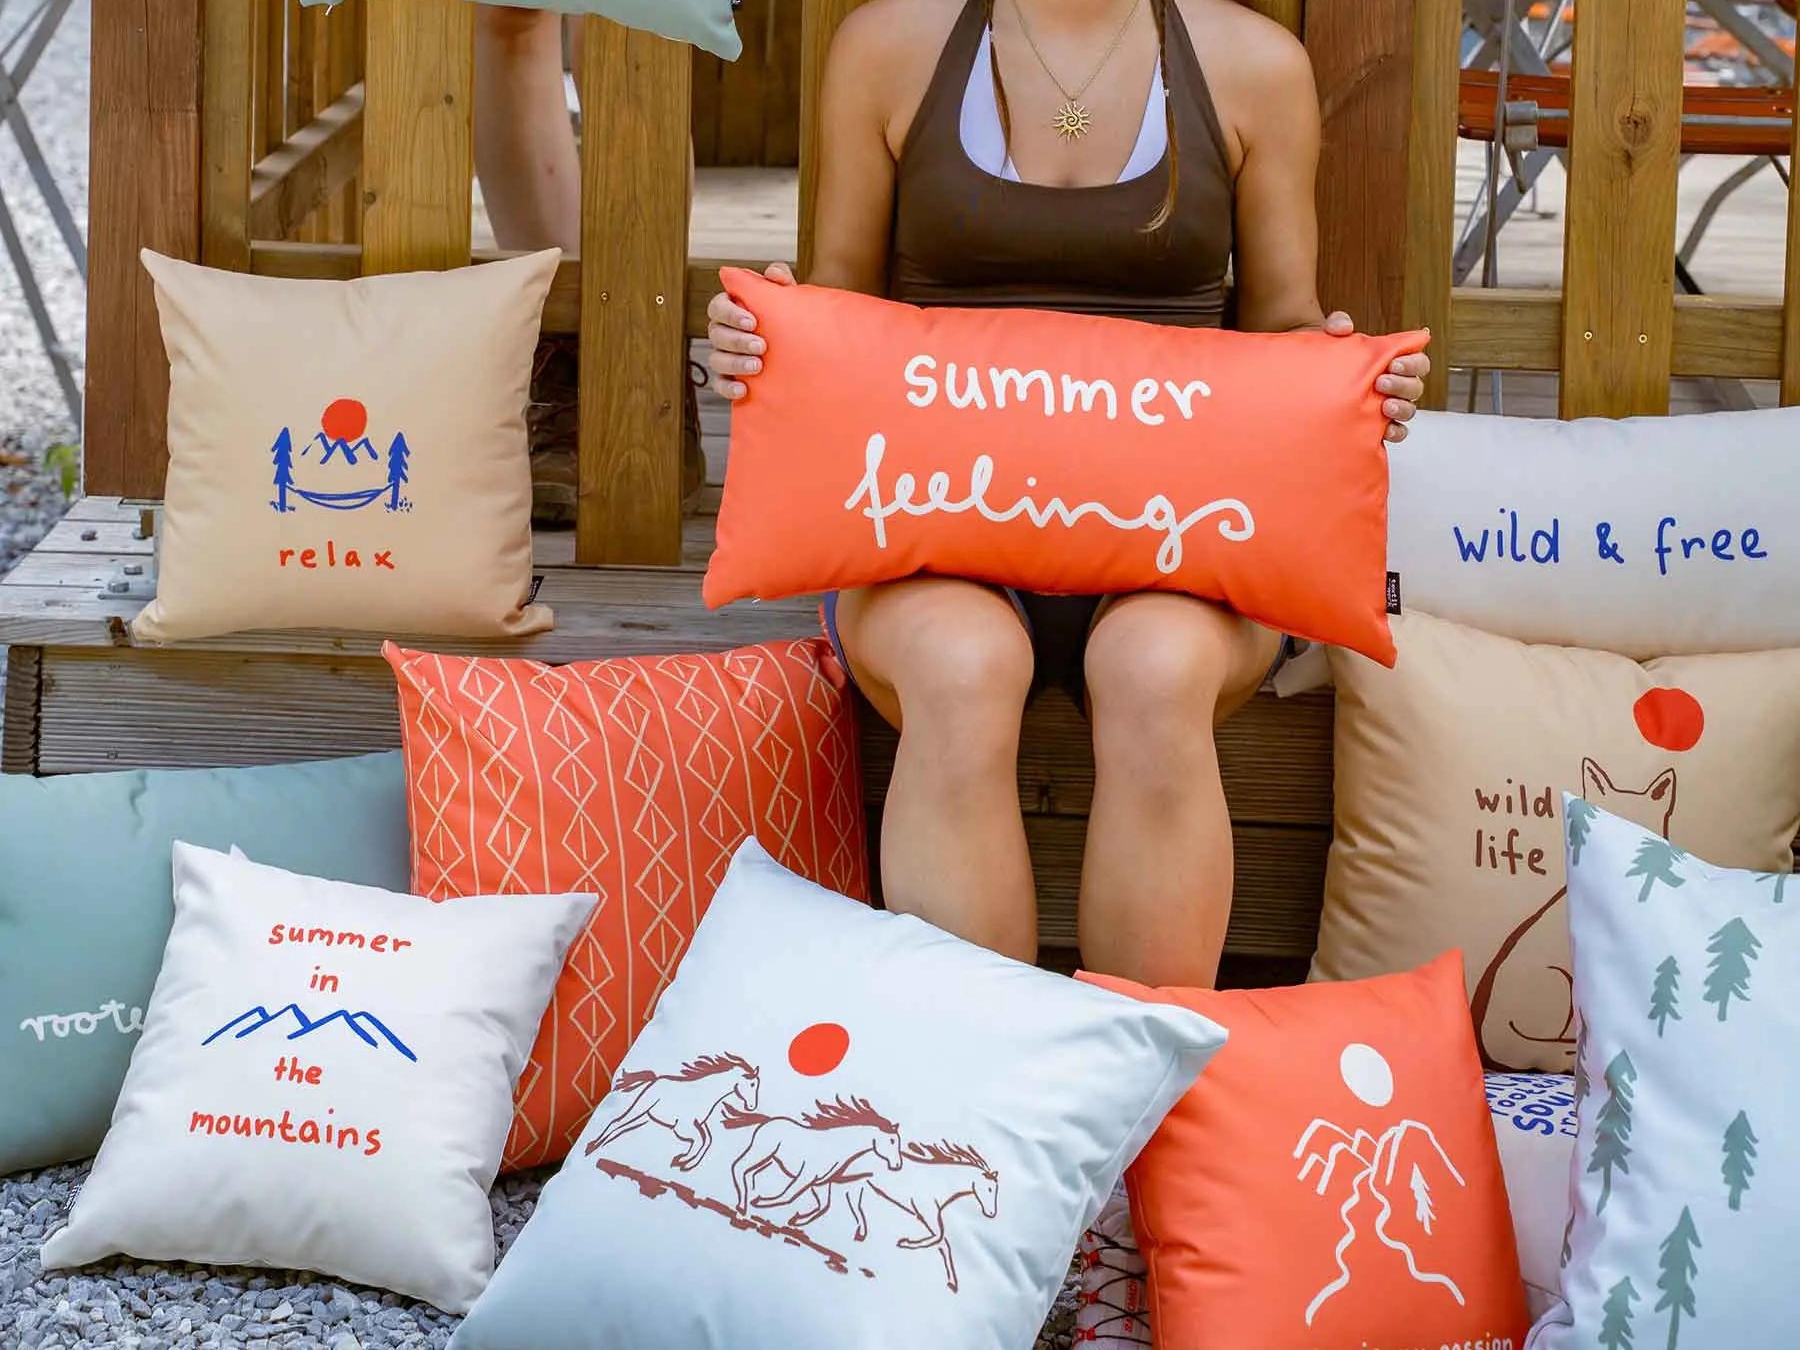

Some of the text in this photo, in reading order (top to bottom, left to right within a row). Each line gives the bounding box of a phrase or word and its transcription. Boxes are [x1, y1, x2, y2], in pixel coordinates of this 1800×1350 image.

[904, 354, 1212, 426] summer
[844, 432, 1255, 575] feelings
[280, 540, 395, 570] relax
[1454, 508, 1768, 575] wild & free
[1475, 778, 1554, 819] wild
[1476, 828, 1547, 876] life
[268, 923, 412, 953] summer
[310, 965, 339, 993] in
[19, 999, 144, 1042] roote
[274, 1056, 323, 1085] the
[189, 1108, 382, 1156] mountains
